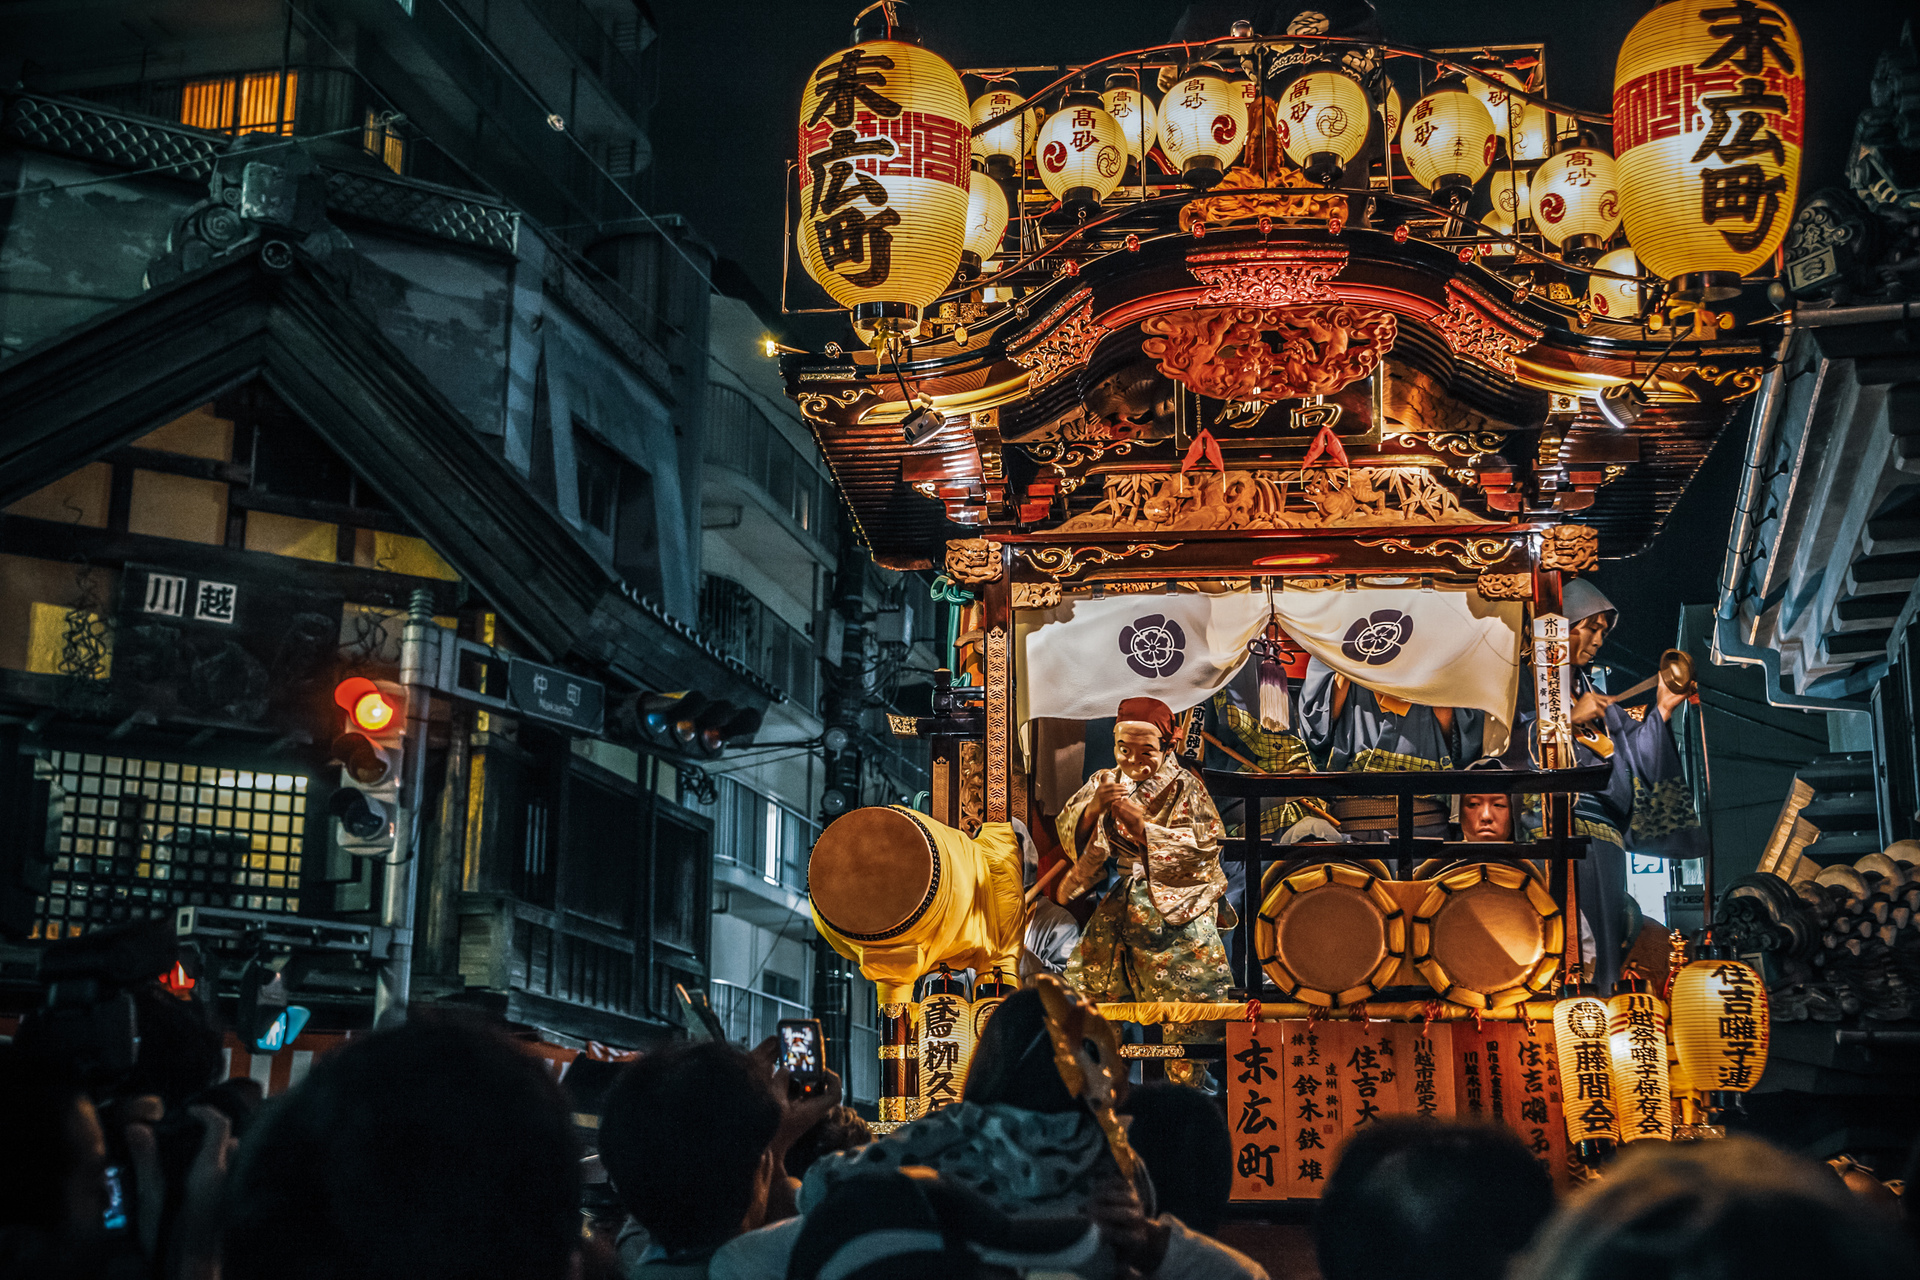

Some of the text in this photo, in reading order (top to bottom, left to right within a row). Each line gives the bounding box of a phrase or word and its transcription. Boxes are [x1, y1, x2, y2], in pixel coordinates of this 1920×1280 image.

[807, 49, 903, 288] 末広町
[1690, 0, 1796, 254] 末広町
[149, 577, 233, 618] 川越
[533, 673, 582, 707] 仲町
[1627, 995, 1666, 1134] 川越祭囃子保存会
[1711, 964, 1758, 1088] 住吉囃子連
[1233, 1039, 1280, 1187] 末広町
[1291, 1074, 1326, 1183] 鈴木鉄雄
[1346, 1045, 1381, 1127] 住吉大
[1517, 1041, 1550, 1158] 住吉囃子
[1573, 1040, 1616, 1132] 藤間会
